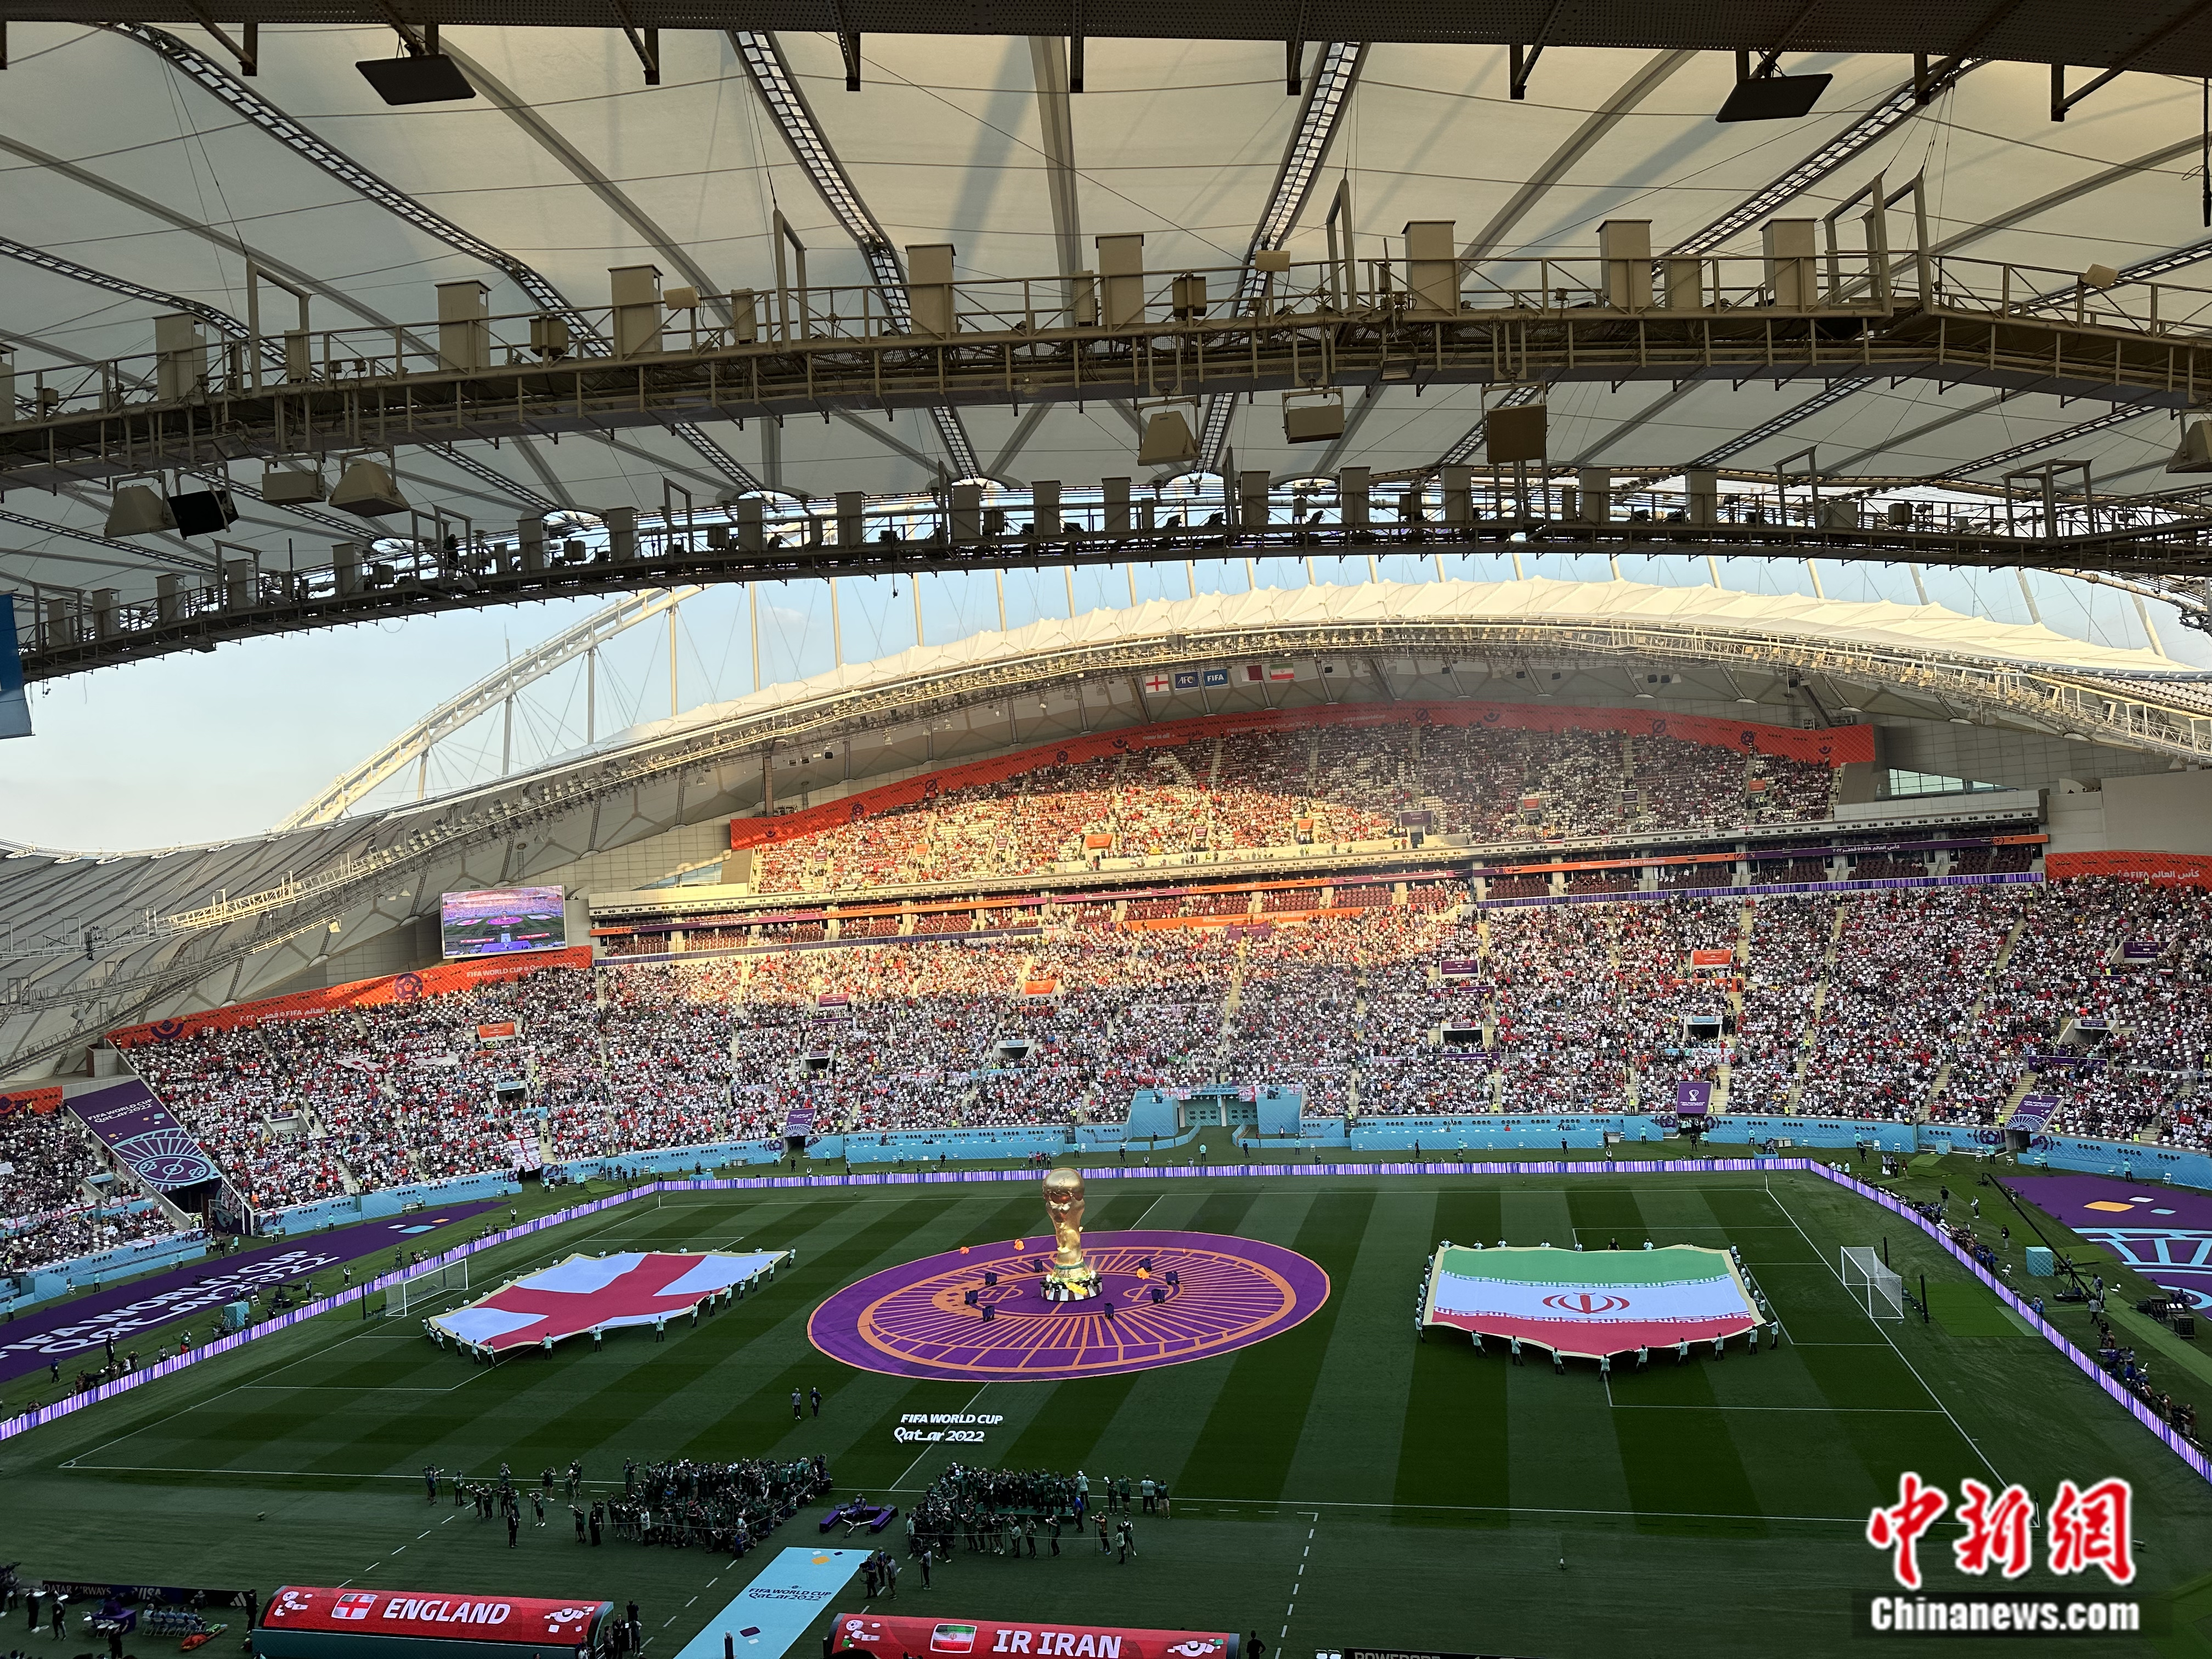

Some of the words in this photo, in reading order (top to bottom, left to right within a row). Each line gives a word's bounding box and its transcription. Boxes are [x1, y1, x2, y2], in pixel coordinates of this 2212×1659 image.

[1178, 675, 1195, 684] AFC
[1207, 674, 1224, 682] FIFA
[2152, 870, 2176, 878] العالم
[2177, 868, 2199, 880] كأس
[483, 968, 509, 976] WORLD
[304, 1007, 325, 1016] العالم
[94, 1111, 128, 1123] Qatar
[127, 1103, 153, 1114] 2022
[106, 1104, 136, 1115] WORLD
[237, 1250, 308, 1274] CUP
[900, 1414, 928, 1424] FIFA
[929, 1414, 975, 1424] WORLD
[977, 1414, 1003, 1425] CUP
[894, 1426, 945, 1443] Qatar
[945, 1430, 985, 1442] 2022
[43, 1583, 72, 1595] QATAR
[132, 1587, 162, 1600] VISA
[382, 1597, 511, 1625] ENGLAND
[992, 1629, 1032, 1654] IR
[1037, 1631, 1121, 1658] IRAN
